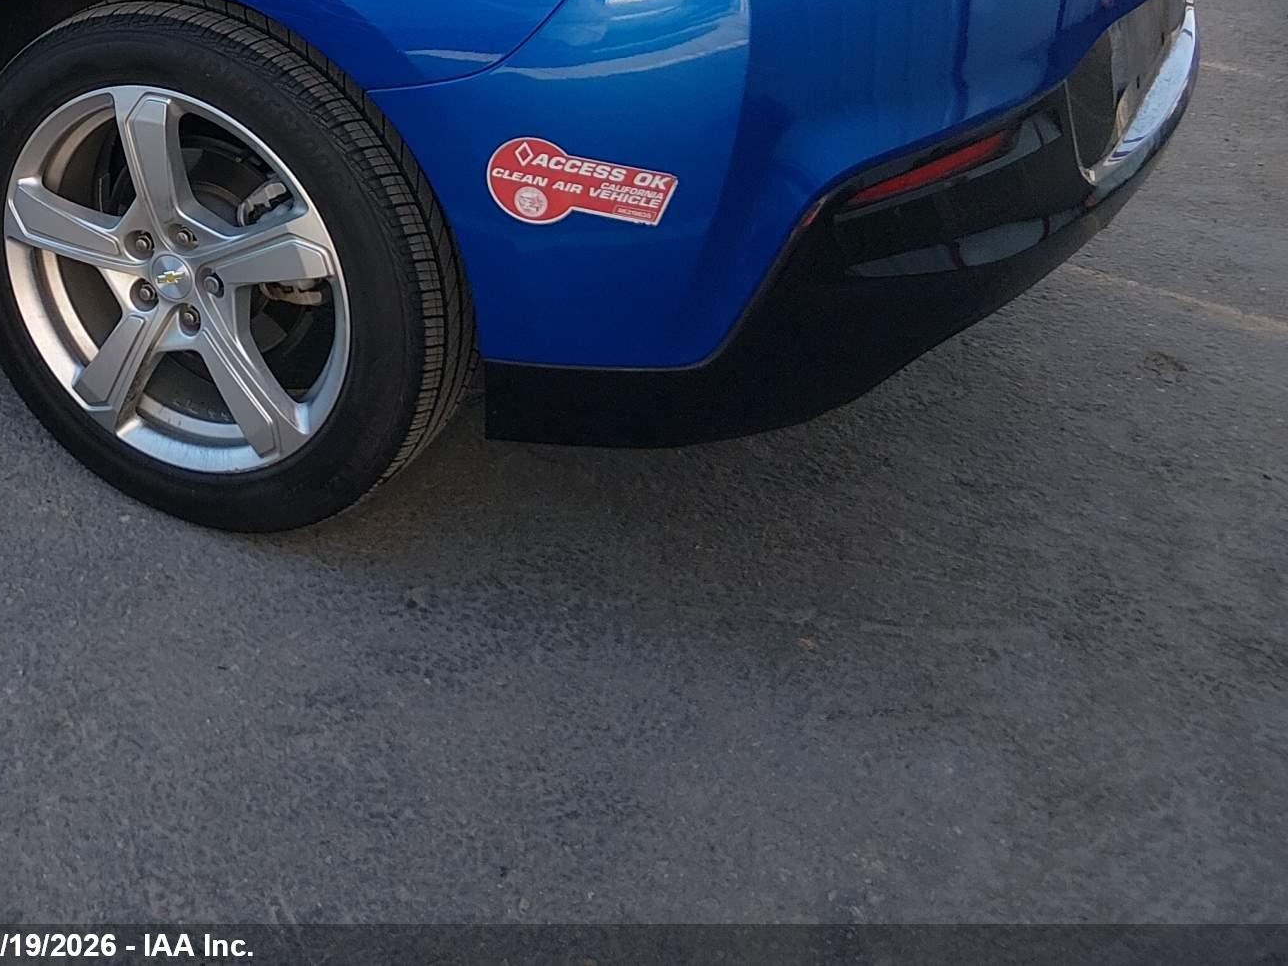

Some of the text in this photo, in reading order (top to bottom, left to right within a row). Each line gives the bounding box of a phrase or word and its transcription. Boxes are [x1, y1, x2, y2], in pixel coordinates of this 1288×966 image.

[491, 167, 662, 209] CLEAN AIR VEHICLE
[531, 153, 672, 190] ACCESS OK
[600, 182, 664, 200] CALIFORNIA
